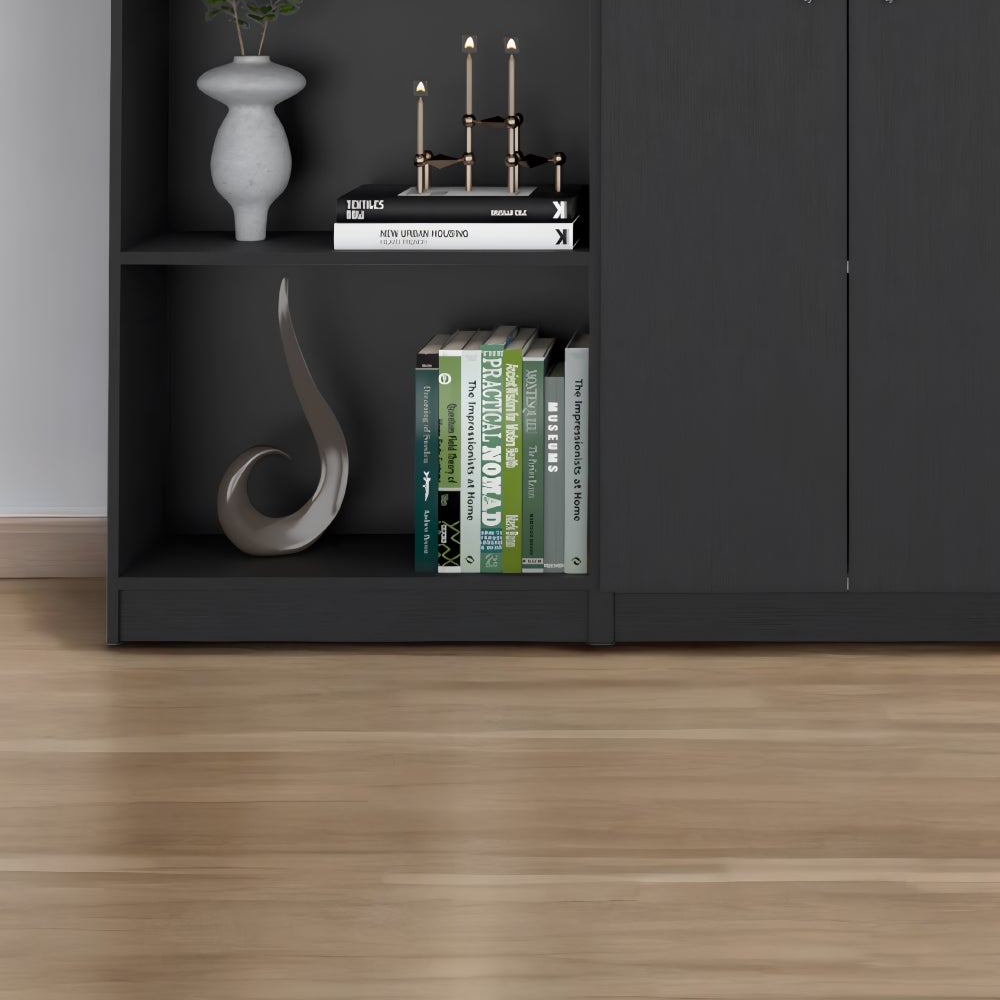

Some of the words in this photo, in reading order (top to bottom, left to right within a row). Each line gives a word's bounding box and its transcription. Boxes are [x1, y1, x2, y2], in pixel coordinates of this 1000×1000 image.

[379, 230, 398, 238] NEW
[401, 230, 428, 238] URBAN
[467, 380, 476, 398] The
[482, 357, 502, 442] PRACTICAL
[573, 379, 583, 397] The
[448, 436, 457, 450] Field
[466, 402, 476, 475] Impressionists
[548, 402, 558, 473] MUSEUMS
[572, 401, 583, 475] Impressionists
[467, 479, 476, 488] at
[481, 446, 502, 526] NOMAD
[574, 479, 582, 489] at
[467, 492, 476, 520] Home
[574, 492, 582, 521] Home
